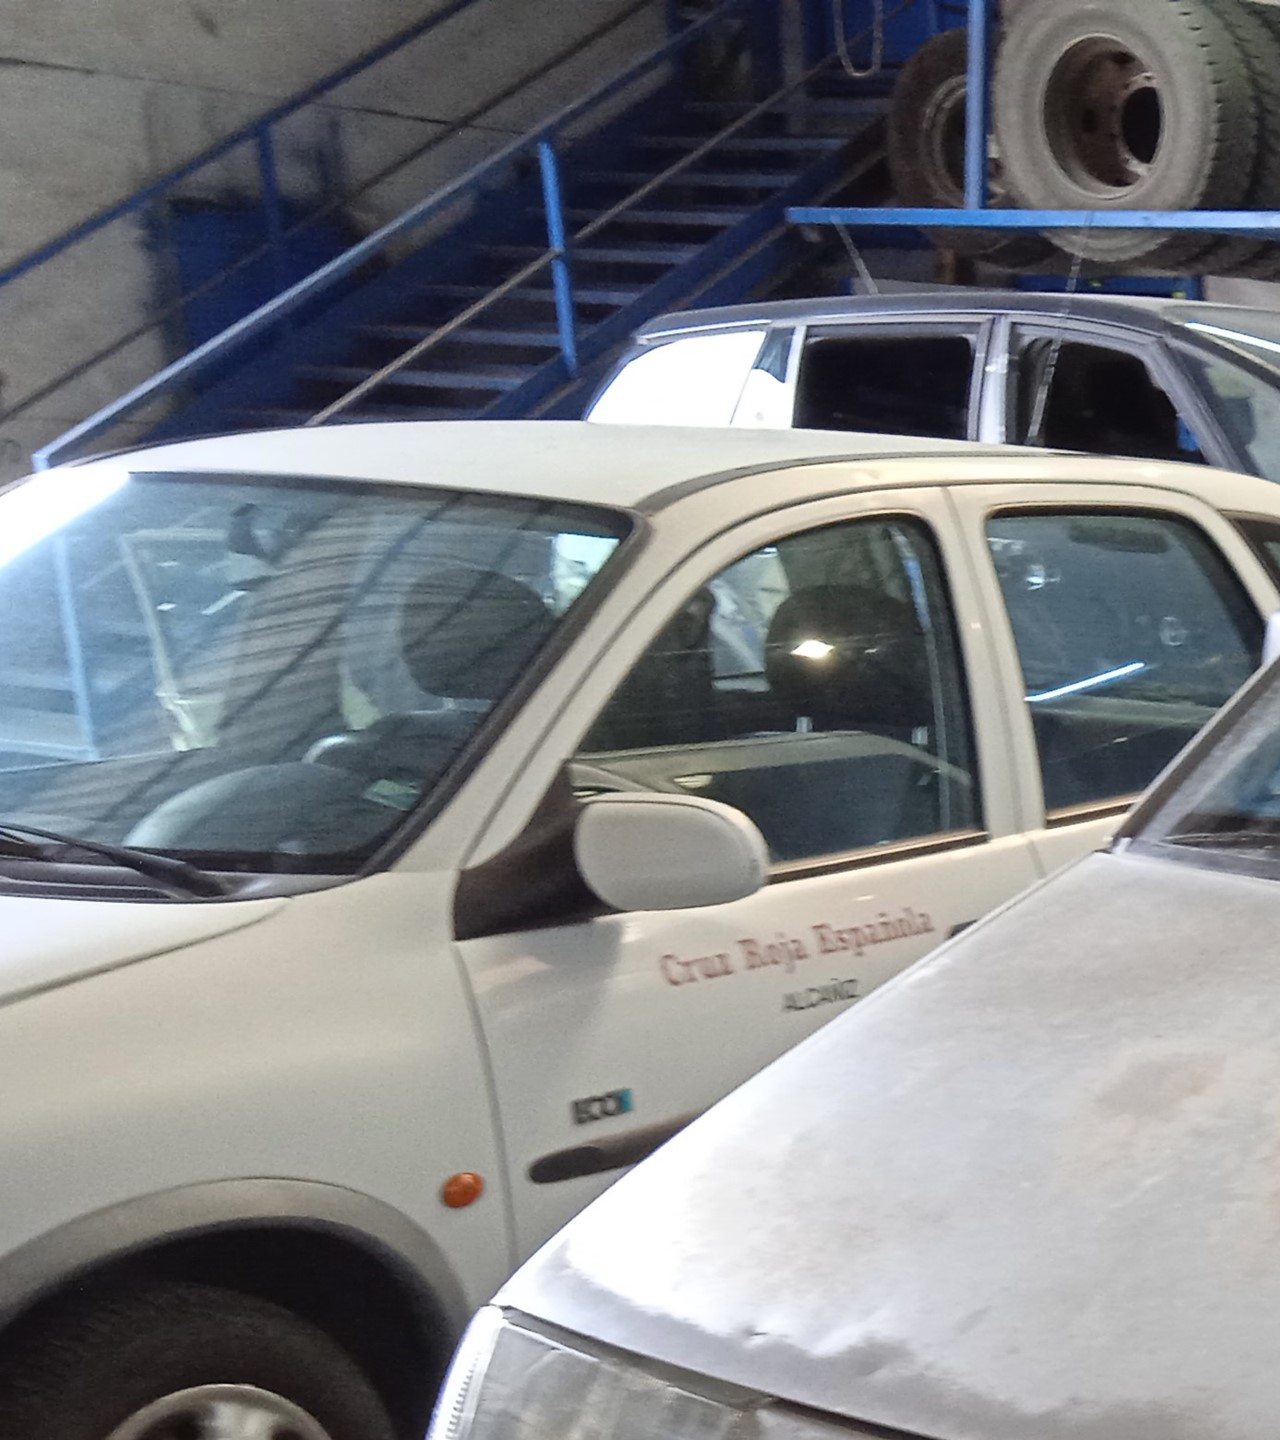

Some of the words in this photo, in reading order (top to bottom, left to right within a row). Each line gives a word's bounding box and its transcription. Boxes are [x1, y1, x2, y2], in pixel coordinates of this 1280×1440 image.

[660, 953, 734, 987] Cruz
[737, 932, 808, 973] Roja
[811, 907, 936, 956] Española
